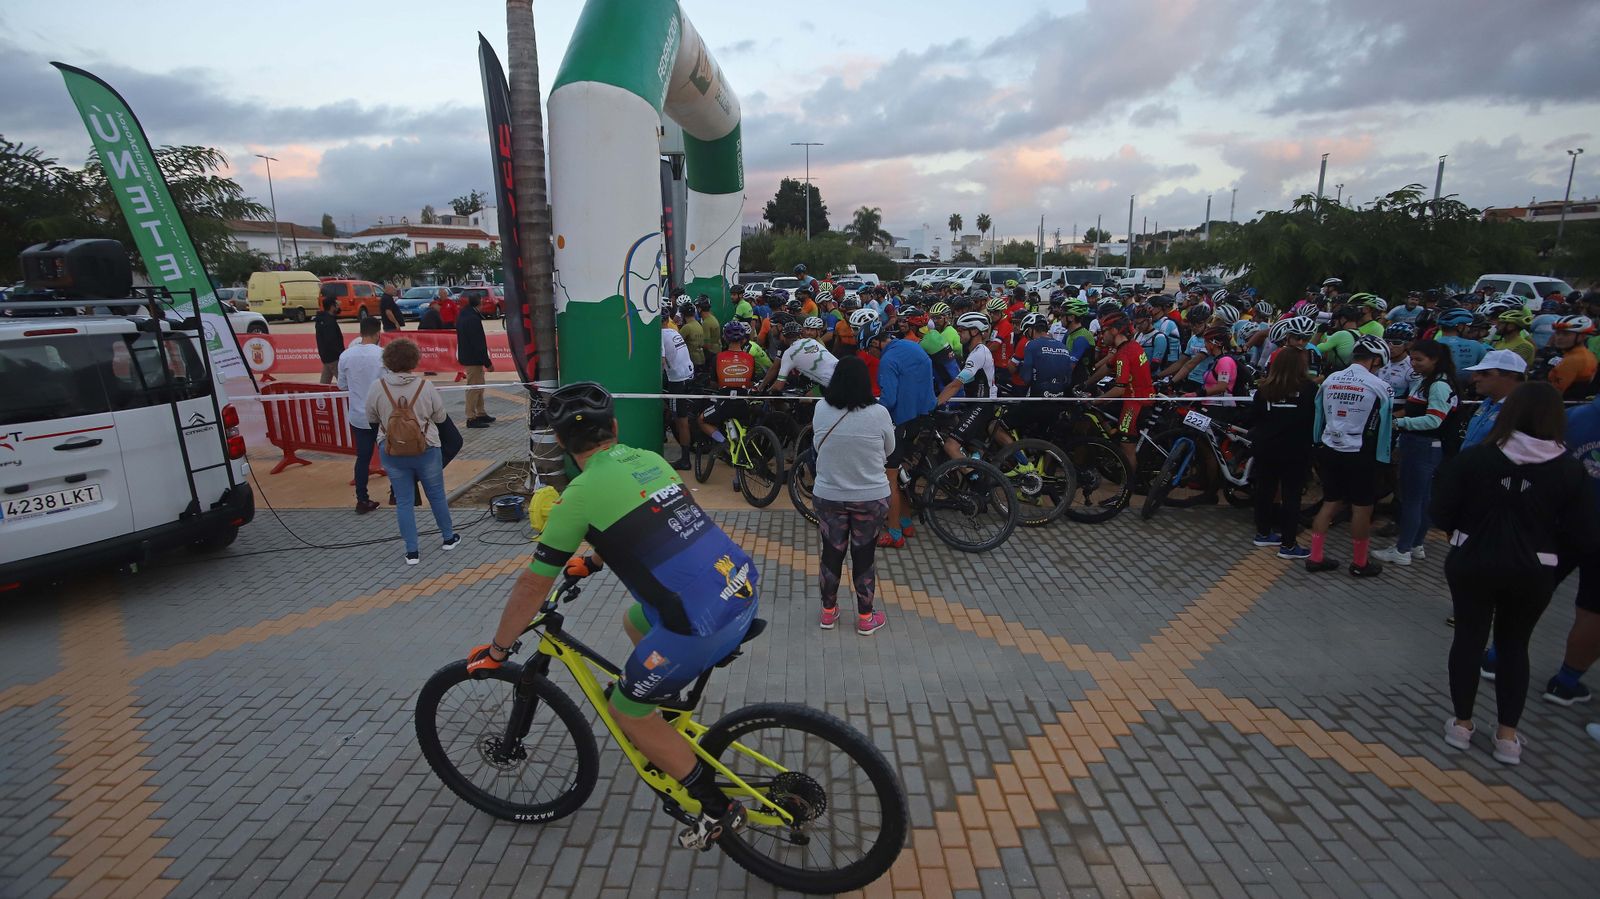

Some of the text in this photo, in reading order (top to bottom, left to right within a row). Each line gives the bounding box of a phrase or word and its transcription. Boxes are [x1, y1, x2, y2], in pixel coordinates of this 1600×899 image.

[1185, 415, 1204, 428] 222
[648, 482, 682, 503] TIPSA
[7, 494, 57, 516] 4238
[60, 487, 94, 506] LKT
[513, 810, 555, 821] MAXXIS
